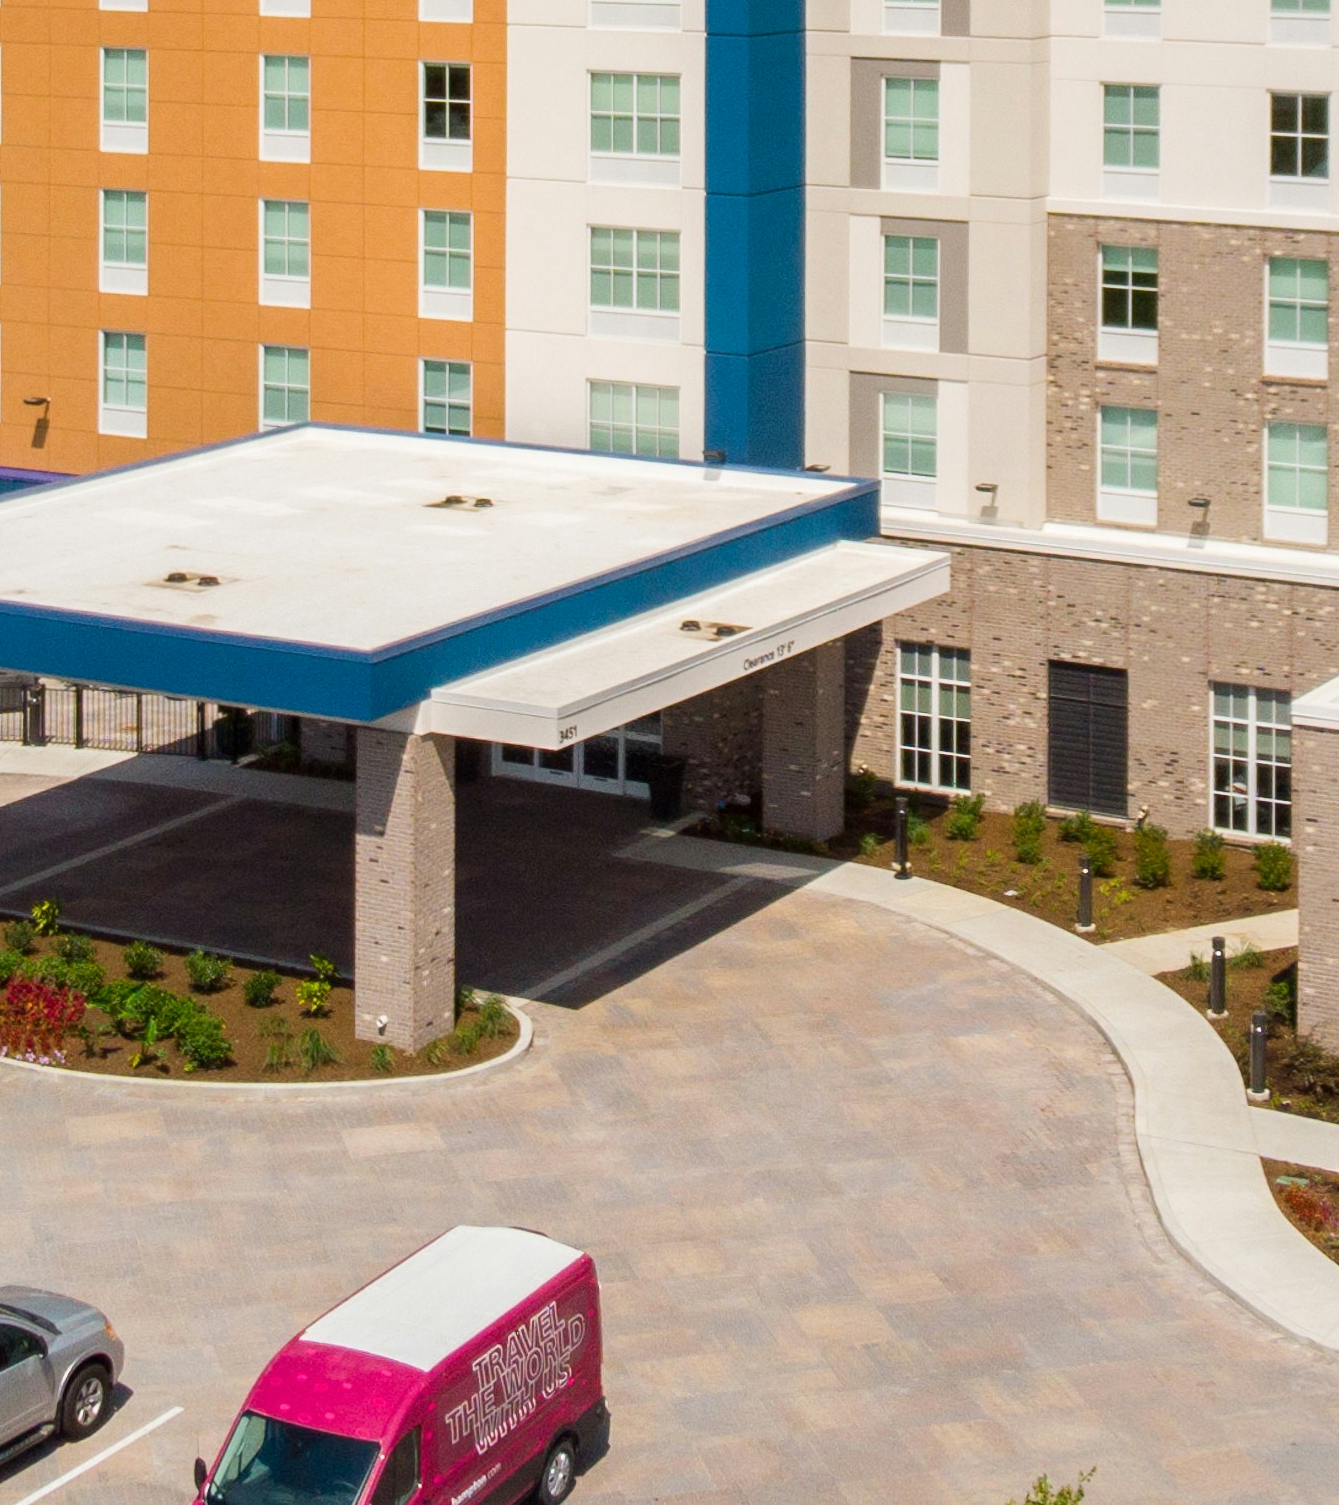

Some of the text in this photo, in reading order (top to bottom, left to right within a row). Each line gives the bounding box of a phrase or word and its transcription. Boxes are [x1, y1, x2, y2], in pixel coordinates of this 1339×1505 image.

[743, 652, 775, 671] Clearance
[559, 725, 578, 743] 3451
[445, 1313, 586, 1445] THE WORLD
[472, 1300, 565, 1392] TRAVEL
[474, 1351, 572, 1455] WITH US
